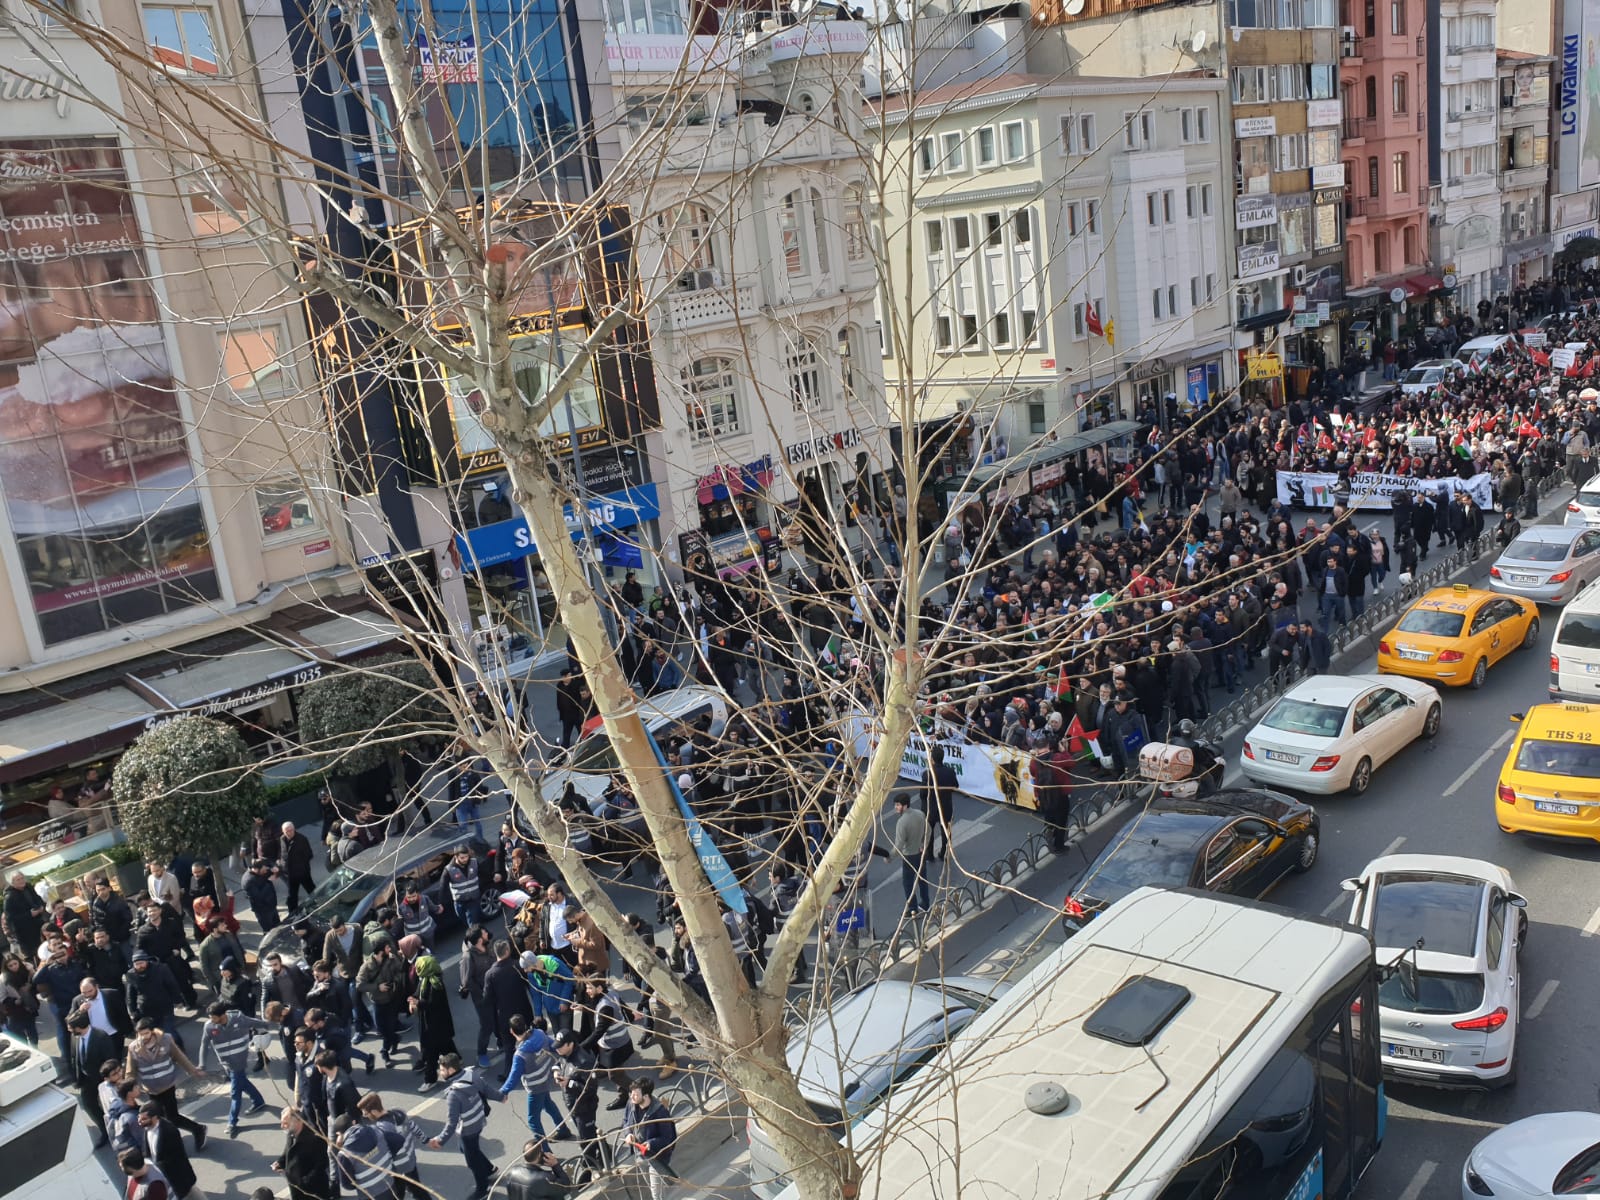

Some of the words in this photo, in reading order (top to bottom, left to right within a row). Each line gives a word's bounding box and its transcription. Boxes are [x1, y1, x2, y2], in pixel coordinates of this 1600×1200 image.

[1561, 111, 1576, 136] LC
[1239, 209, 1274, 223] EMLAK
[1241, 254, 1276, 271] EMLAK
[293, 665, 323, 686] 1935
[1546, 730, 1574, 740] THS
[1577, 732, 1592, 741] 42
[1394, 1046, 1404, 1055] 06
[1409, 1047, 1423, 1057] YLY
[1432, 1051, 1442, 1060] 61
